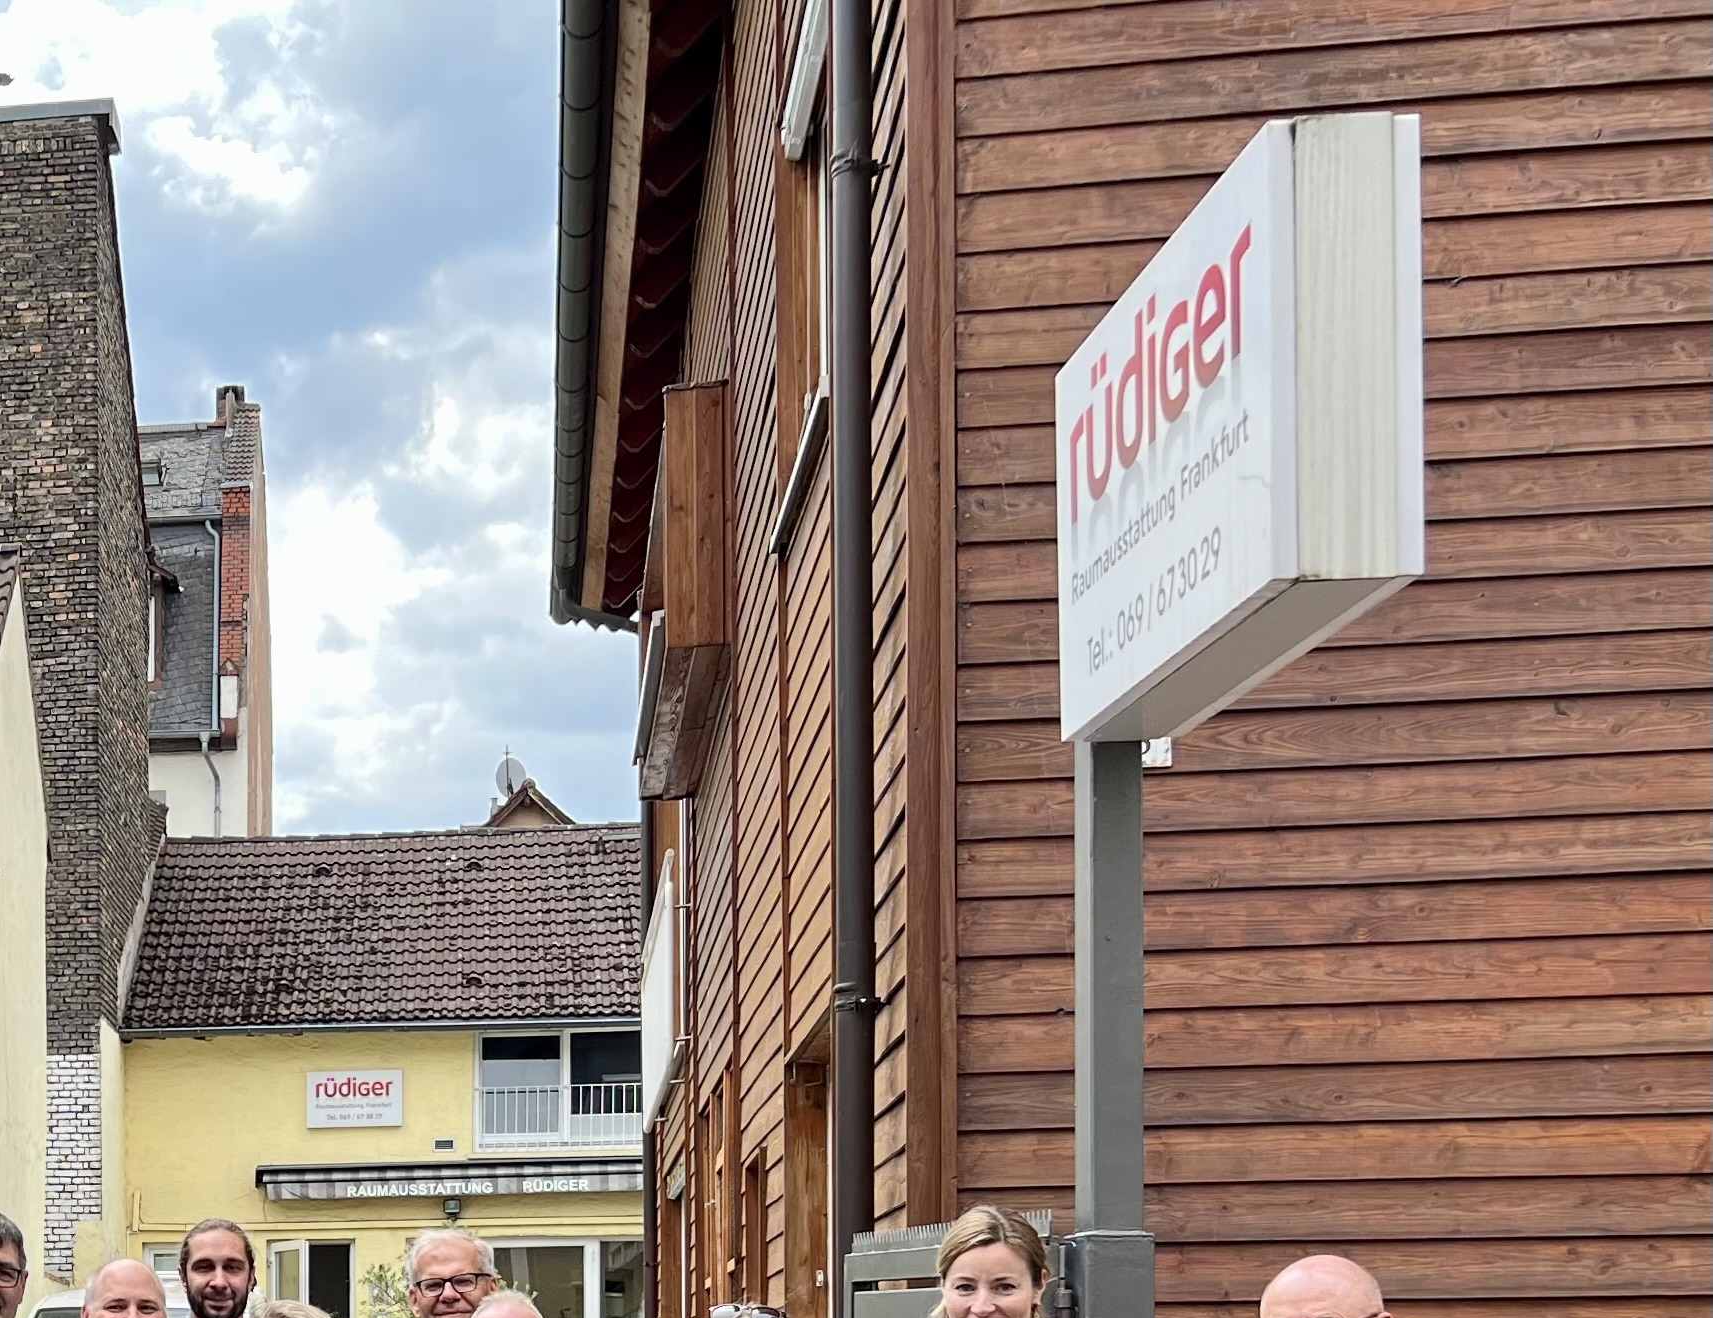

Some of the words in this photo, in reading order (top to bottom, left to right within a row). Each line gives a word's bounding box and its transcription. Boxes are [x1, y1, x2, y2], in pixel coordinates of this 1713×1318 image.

[1070, 221, 1252, 526] rüdiger
[1071, 485, 1176, 606] Raumausstattung
[1180, 408, 1249, 501] Frankfurt
[1087, 626, 1113, 676] Tel.:
[1117, 594, 1144, 650] 069
[315, 1077, 393, 1098] rüdiger
[346, 1182, 494, 1198] RAUMAUSSTATTUNG
[522, 1178, 589, 1193] RÜDIGER
